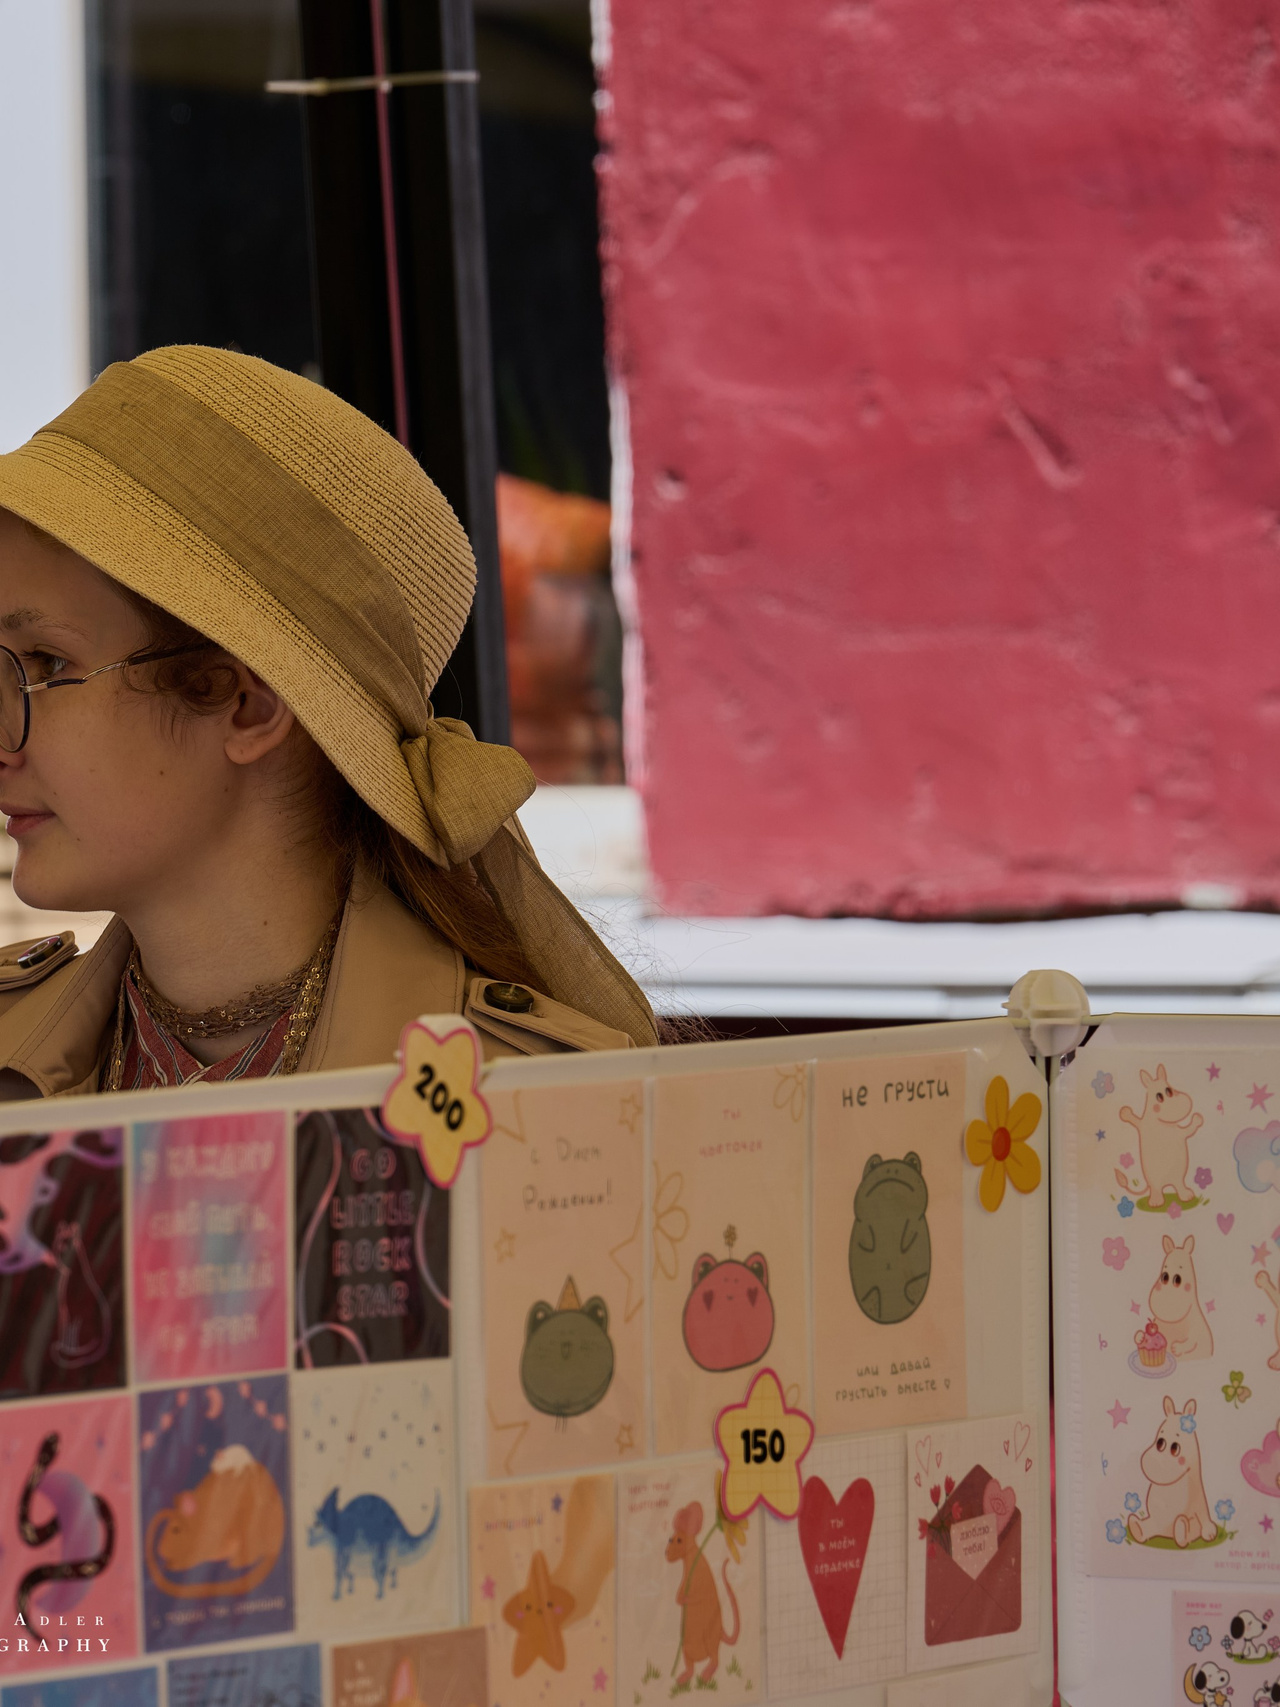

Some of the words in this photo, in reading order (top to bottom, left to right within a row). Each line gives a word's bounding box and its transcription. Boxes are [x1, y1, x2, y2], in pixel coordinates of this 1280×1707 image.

[414, 1063, 464, 1131] 200
[842, 1085, 868, 1107] не
[884, 1079, 949, 1103] грусти
[350, 1146, 397, 1182] GO
[330, 1189, 416, 1230] LITTLE
[332, 1236, 412, 1277] ROCK
[337, 1280, 409, 1322] STAR
[890, 1356, 931, 1376] давай
[835, 1386, 888, 1402] грустить
[897, 1379, 937, 1395] вместе
[741, 1428, 785, 1464] 150
